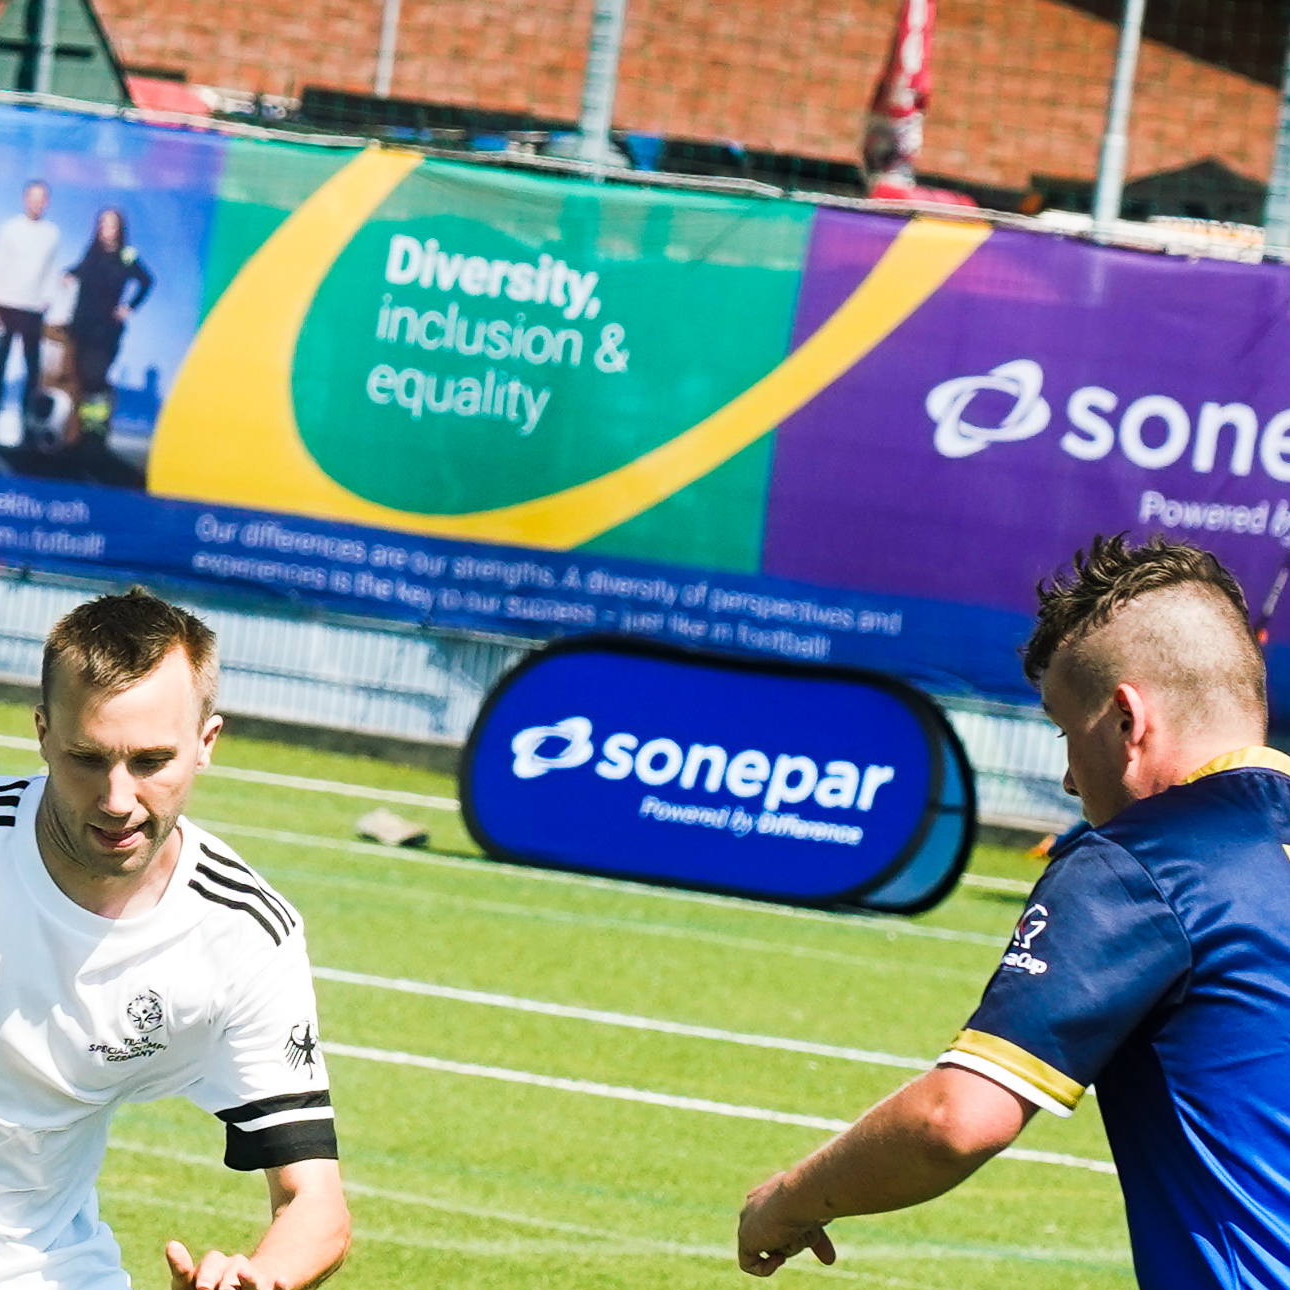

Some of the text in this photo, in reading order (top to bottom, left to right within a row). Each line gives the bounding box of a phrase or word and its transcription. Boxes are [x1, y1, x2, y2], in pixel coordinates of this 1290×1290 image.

[385, 233, 601, 320] Diversity,
[376, 292, 630, 373] inclusion &
[366, 363, 551, 436] equality
[1138, 490, 1269, 536] Powered
[594, 732, 895, 813] sonepar
[639, 795, 865, 846] Powered by Difference
